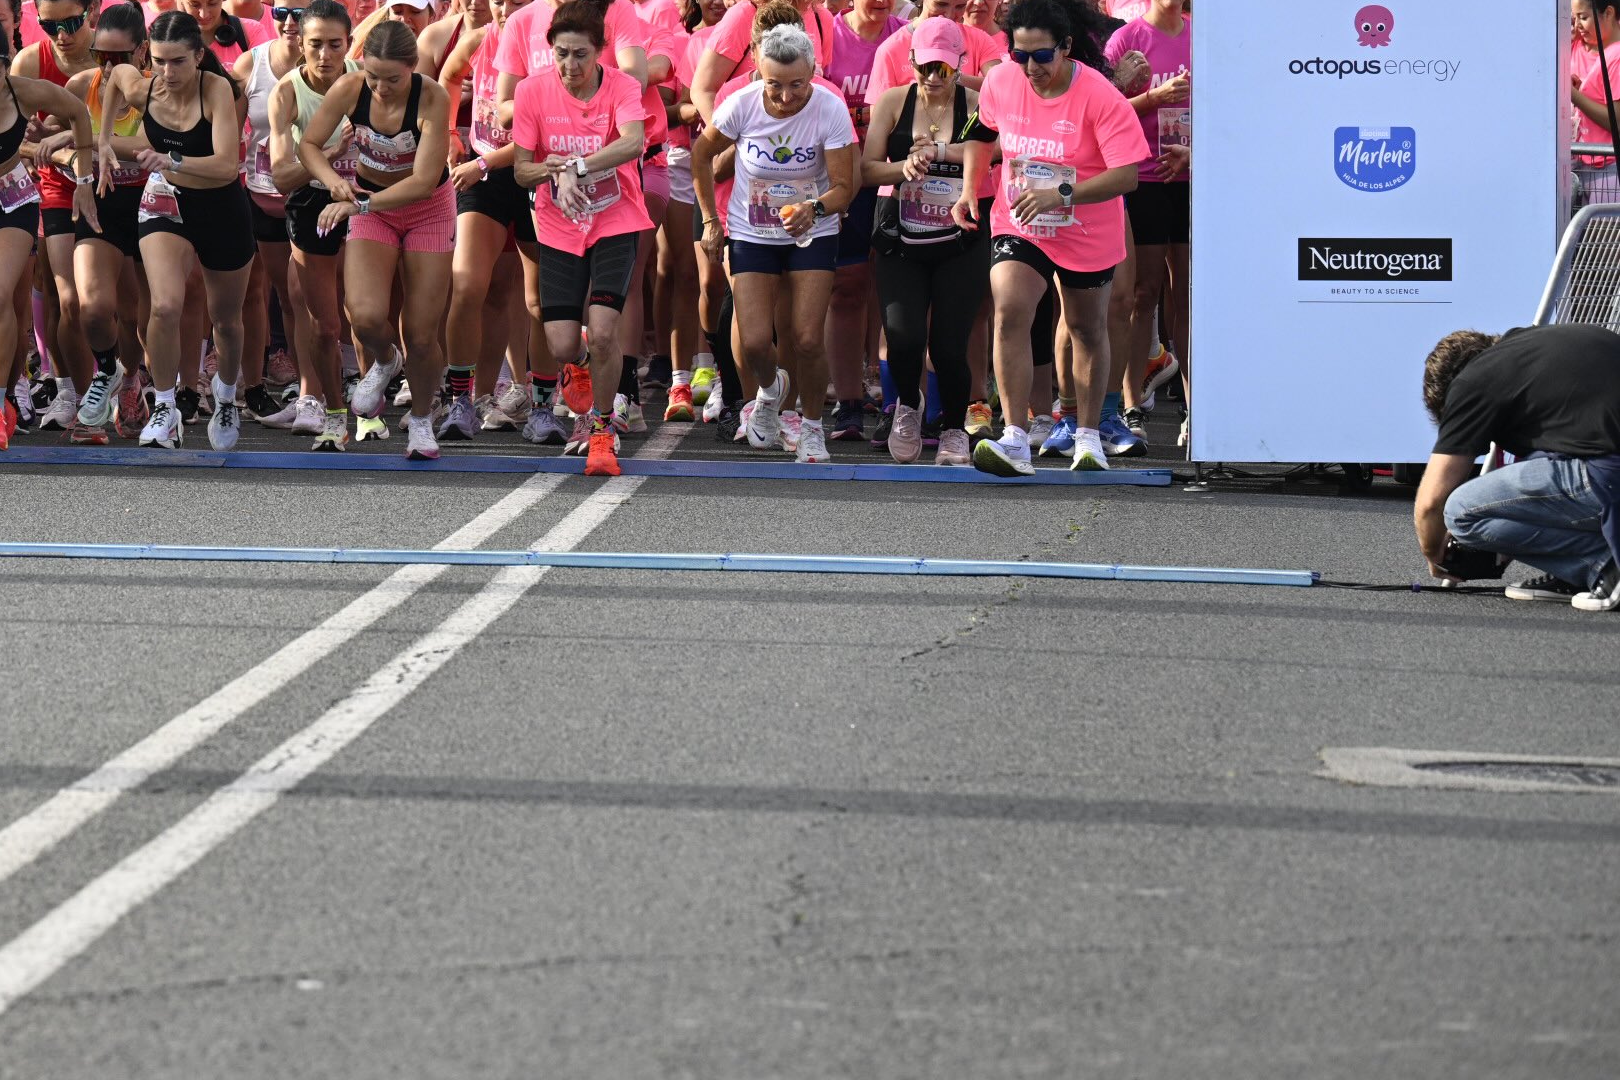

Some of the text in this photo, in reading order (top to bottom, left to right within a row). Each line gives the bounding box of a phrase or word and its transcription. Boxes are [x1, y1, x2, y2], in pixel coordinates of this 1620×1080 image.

[1288, 57, 1461, 82] octopus energy
[163, 138, 183, 147] OYSHO
[1004, 132, 1065, 160] CARRERA
[333, 159, 357, 169] 016
[1339, 141, 1411, 174] Marlene
[113, 168, 140, 177] 016
[1343, 173, 1357, 184] HIJA
[1385, 174, 1406, 188] ALPES
[580, 184, 597, 195] 16
[921, 204, 949, 216] 016
[1309, 247, 1441, 276] Neutrogena
